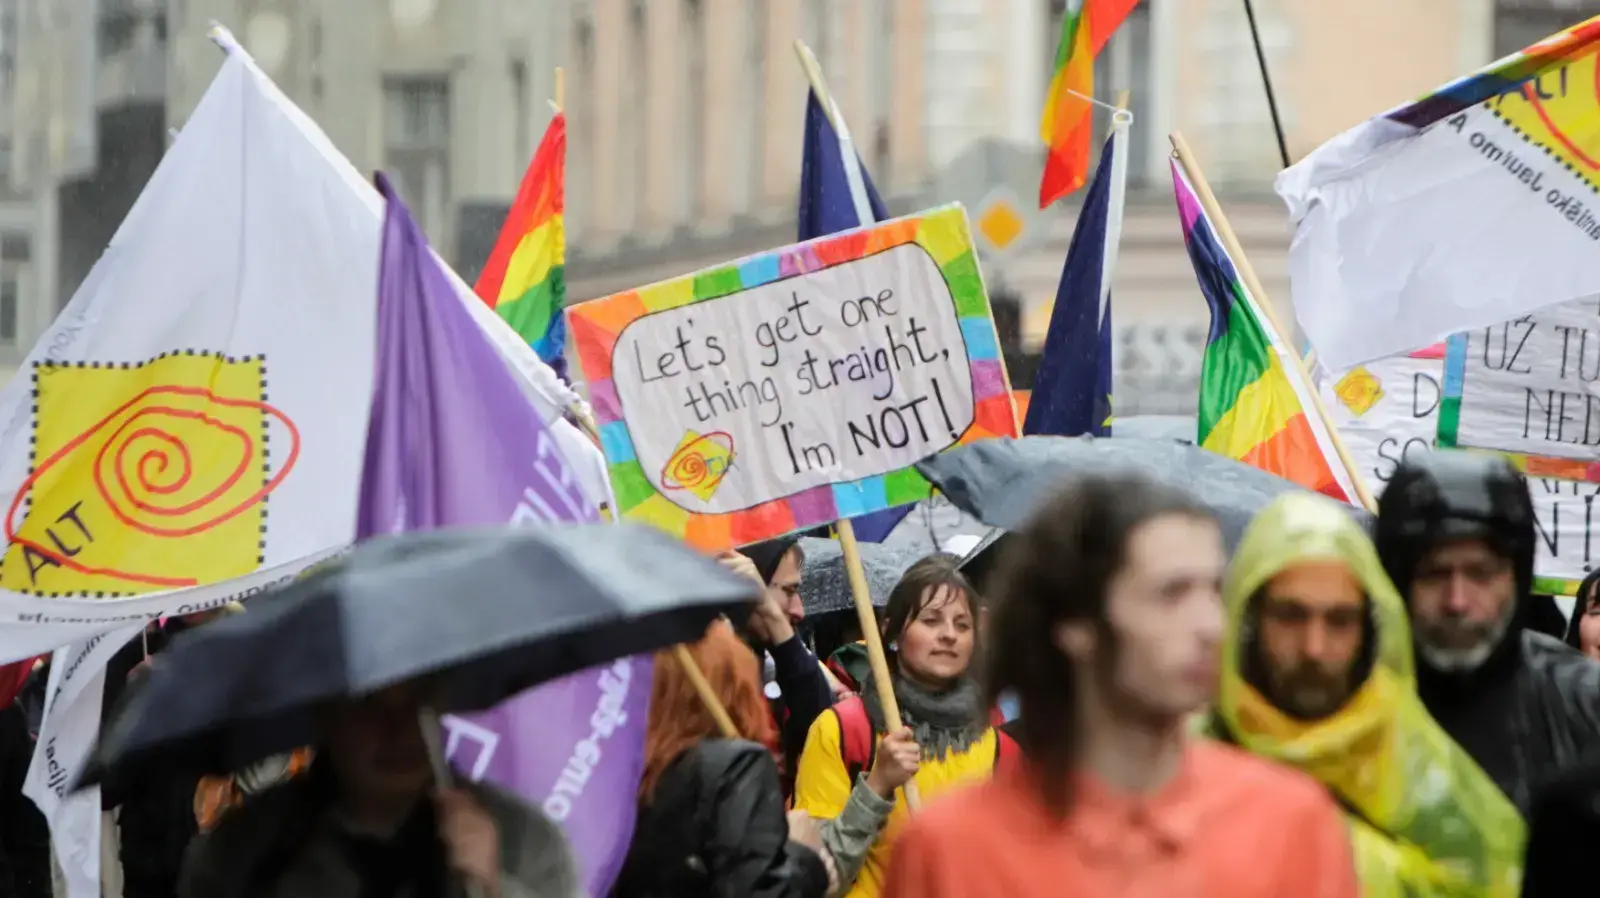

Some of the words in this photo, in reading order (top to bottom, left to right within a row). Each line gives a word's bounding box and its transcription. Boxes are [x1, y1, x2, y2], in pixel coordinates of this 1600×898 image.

[633, 318, 727, 383] Let's
[756, 291, 823, 367] get
[841, 288, 898, 328] one
[684, 376, 783, 428] thing
[797, 317, 950, 401] straight,
[780, 421, 836, 475] I'm
[847, 377, 960, 456] NOT!
